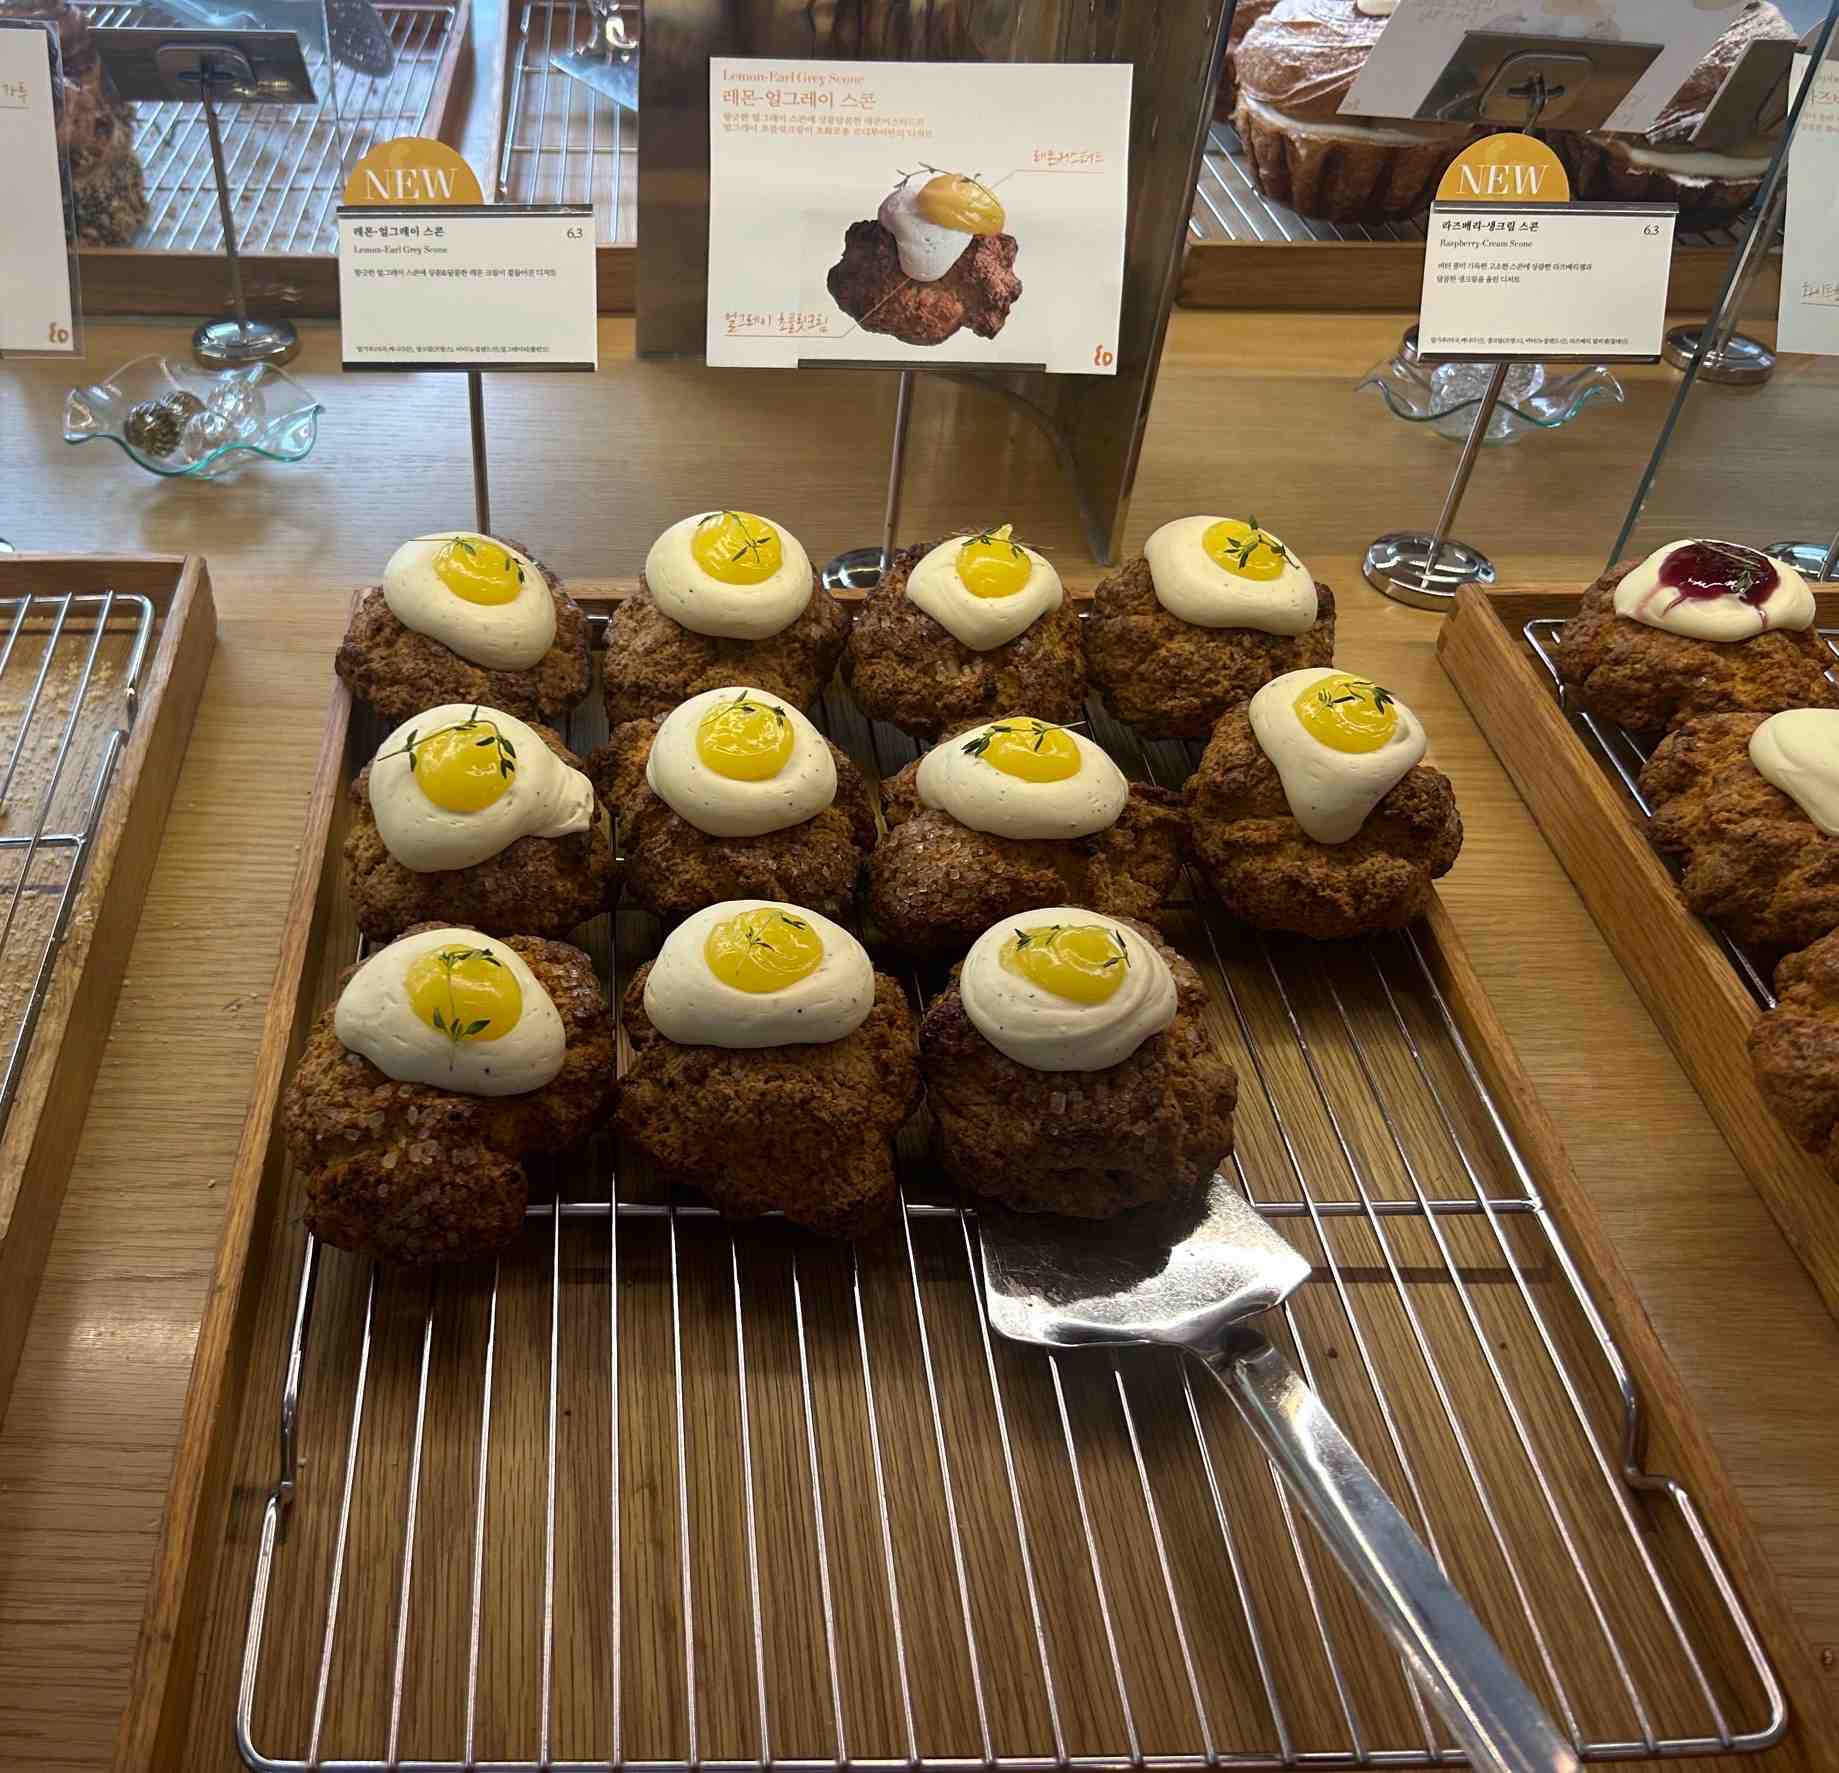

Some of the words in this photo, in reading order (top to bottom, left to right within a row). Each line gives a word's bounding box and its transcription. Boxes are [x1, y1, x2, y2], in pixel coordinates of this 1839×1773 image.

[722, 87, 834, 110] 레몬-얼그레이
[839, 91, 877, 110] 스콘
[365, 167, 458, 200] NEW
[1454, 163, 1550, 196] NEW
[352, 225, 420, 238] 레몬-얼그레이
[423, 226, 445, 238] 스콘
[1441, 220, 1516, 233] 라즈베리-생크림
[1519, 221, 1540, 233] 스콘
